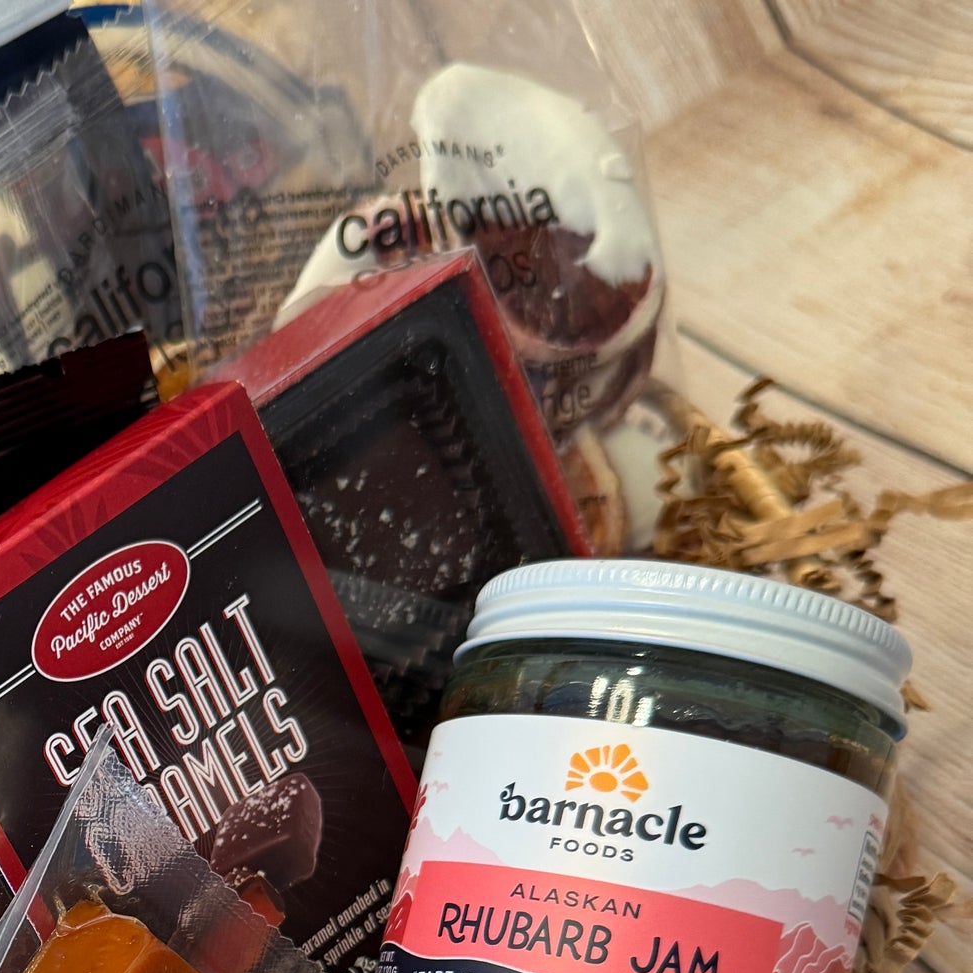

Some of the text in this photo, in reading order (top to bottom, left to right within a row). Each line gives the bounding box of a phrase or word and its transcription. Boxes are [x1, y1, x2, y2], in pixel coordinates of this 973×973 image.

[336, 178, 559, 260] california
[50, 562, 171, 659] Pacific Dessert
[60, 559, 142, 622] THE FAMOUS
[144, 593, 276, 745] SALT
[499, 781, 707, 850] barnacle
[549, 837, 634, 862] FOODS
[337, 884, 378, 927] enrobed
[376, 879, 390, 895] in
[510, 883, 642, 920] ALASKAN
[323, 927, 364, 965] sprinkle
[363, 912, 376, 933] of
[438, 903, 612, 964] RHUBARB
